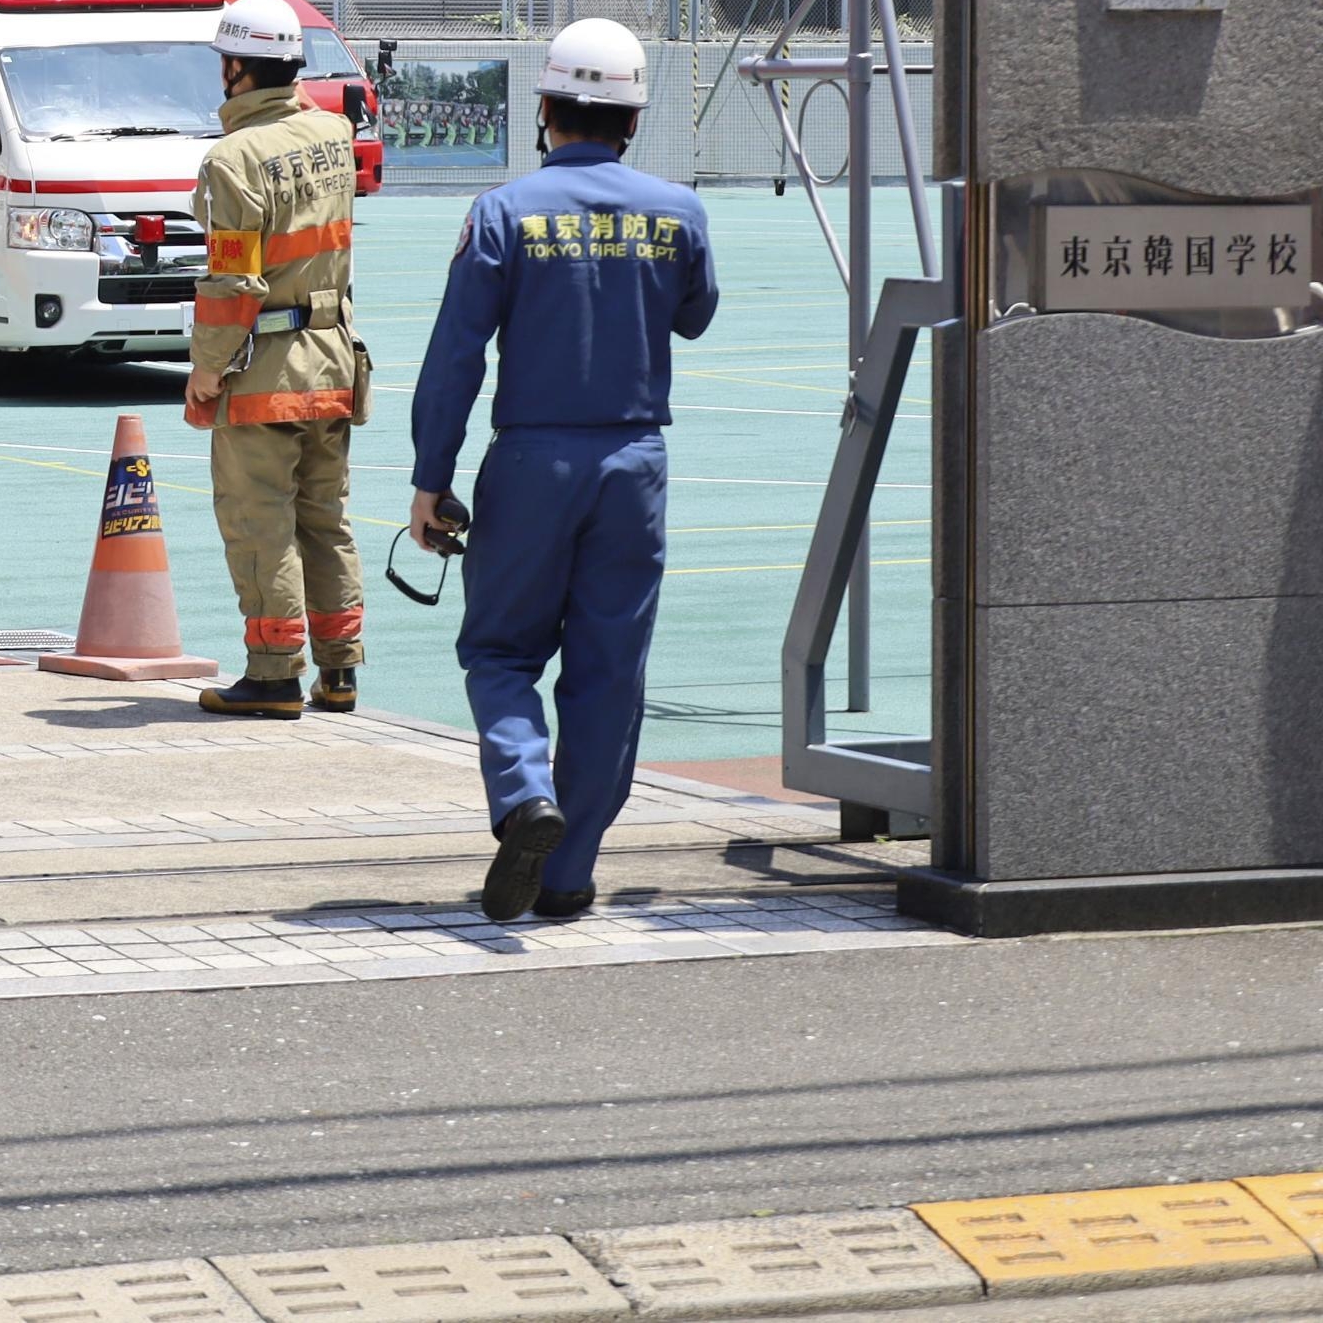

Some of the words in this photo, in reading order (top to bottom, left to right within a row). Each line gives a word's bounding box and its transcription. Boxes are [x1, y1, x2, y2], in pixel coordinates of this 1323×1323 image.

[521, 212, 681, 244] 東京消防庁
[524, 243, 582, 258] TOKYO
[590, 243, 627, 257] FIRE
[636, 243, 677, 261] DEPT.
[1060, 233, 1298, 277] 東京韓国学校
